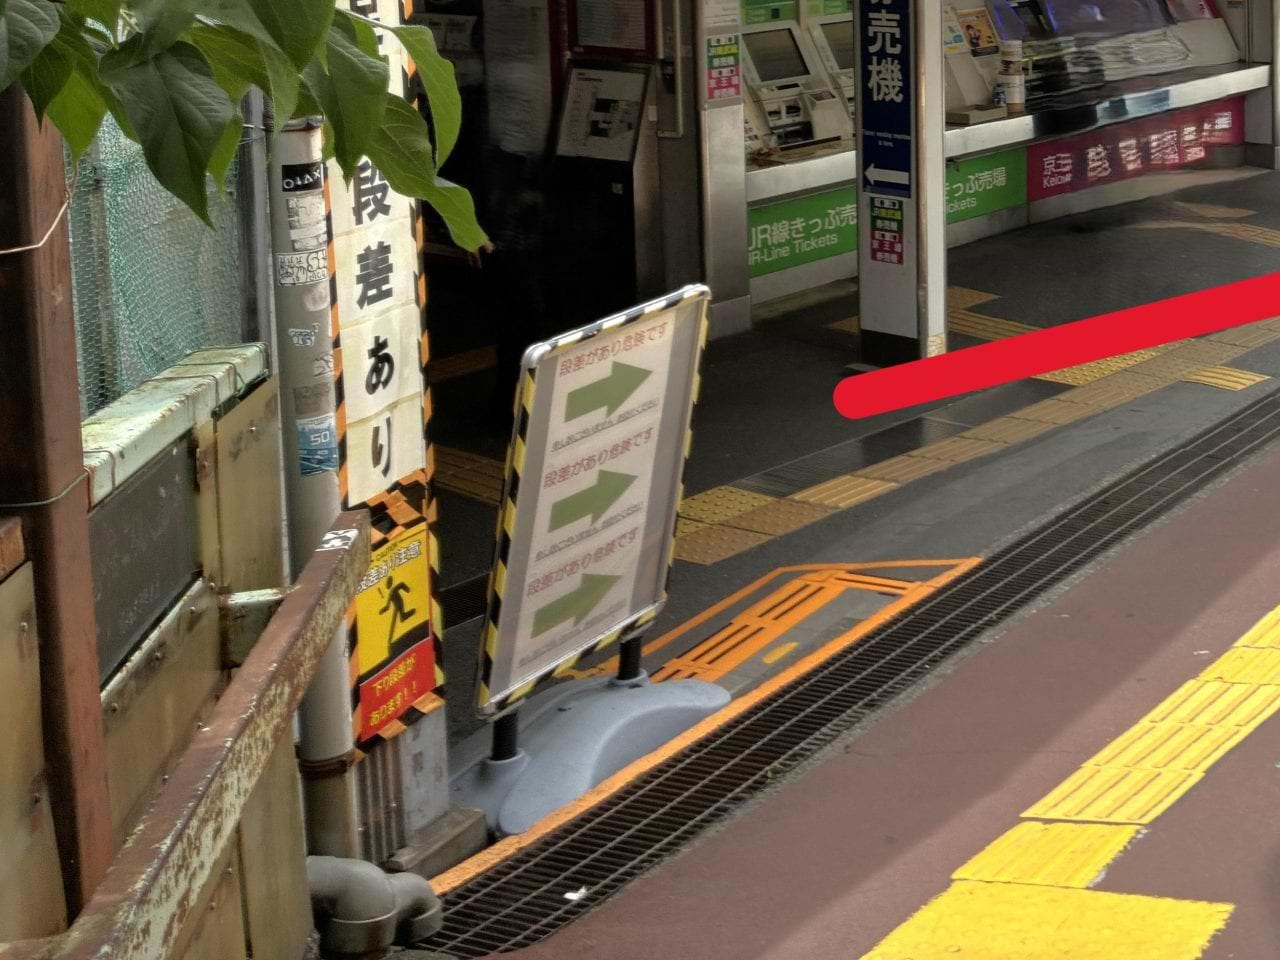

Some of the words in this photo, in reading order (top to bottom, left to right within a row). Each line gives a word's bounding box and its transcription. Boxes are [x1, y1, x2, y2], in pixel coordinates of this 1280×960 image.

[946, 197, 977, 213] ickets
[793, 233, 838, 253] Tickets
[559, 320, 669, 378] 段差があり危険です
[310, 431, 329, 446] 50
[543, 426, 655, 489] 段差があり危険です
[527, 527, 640, 598] 段差があり危険です
